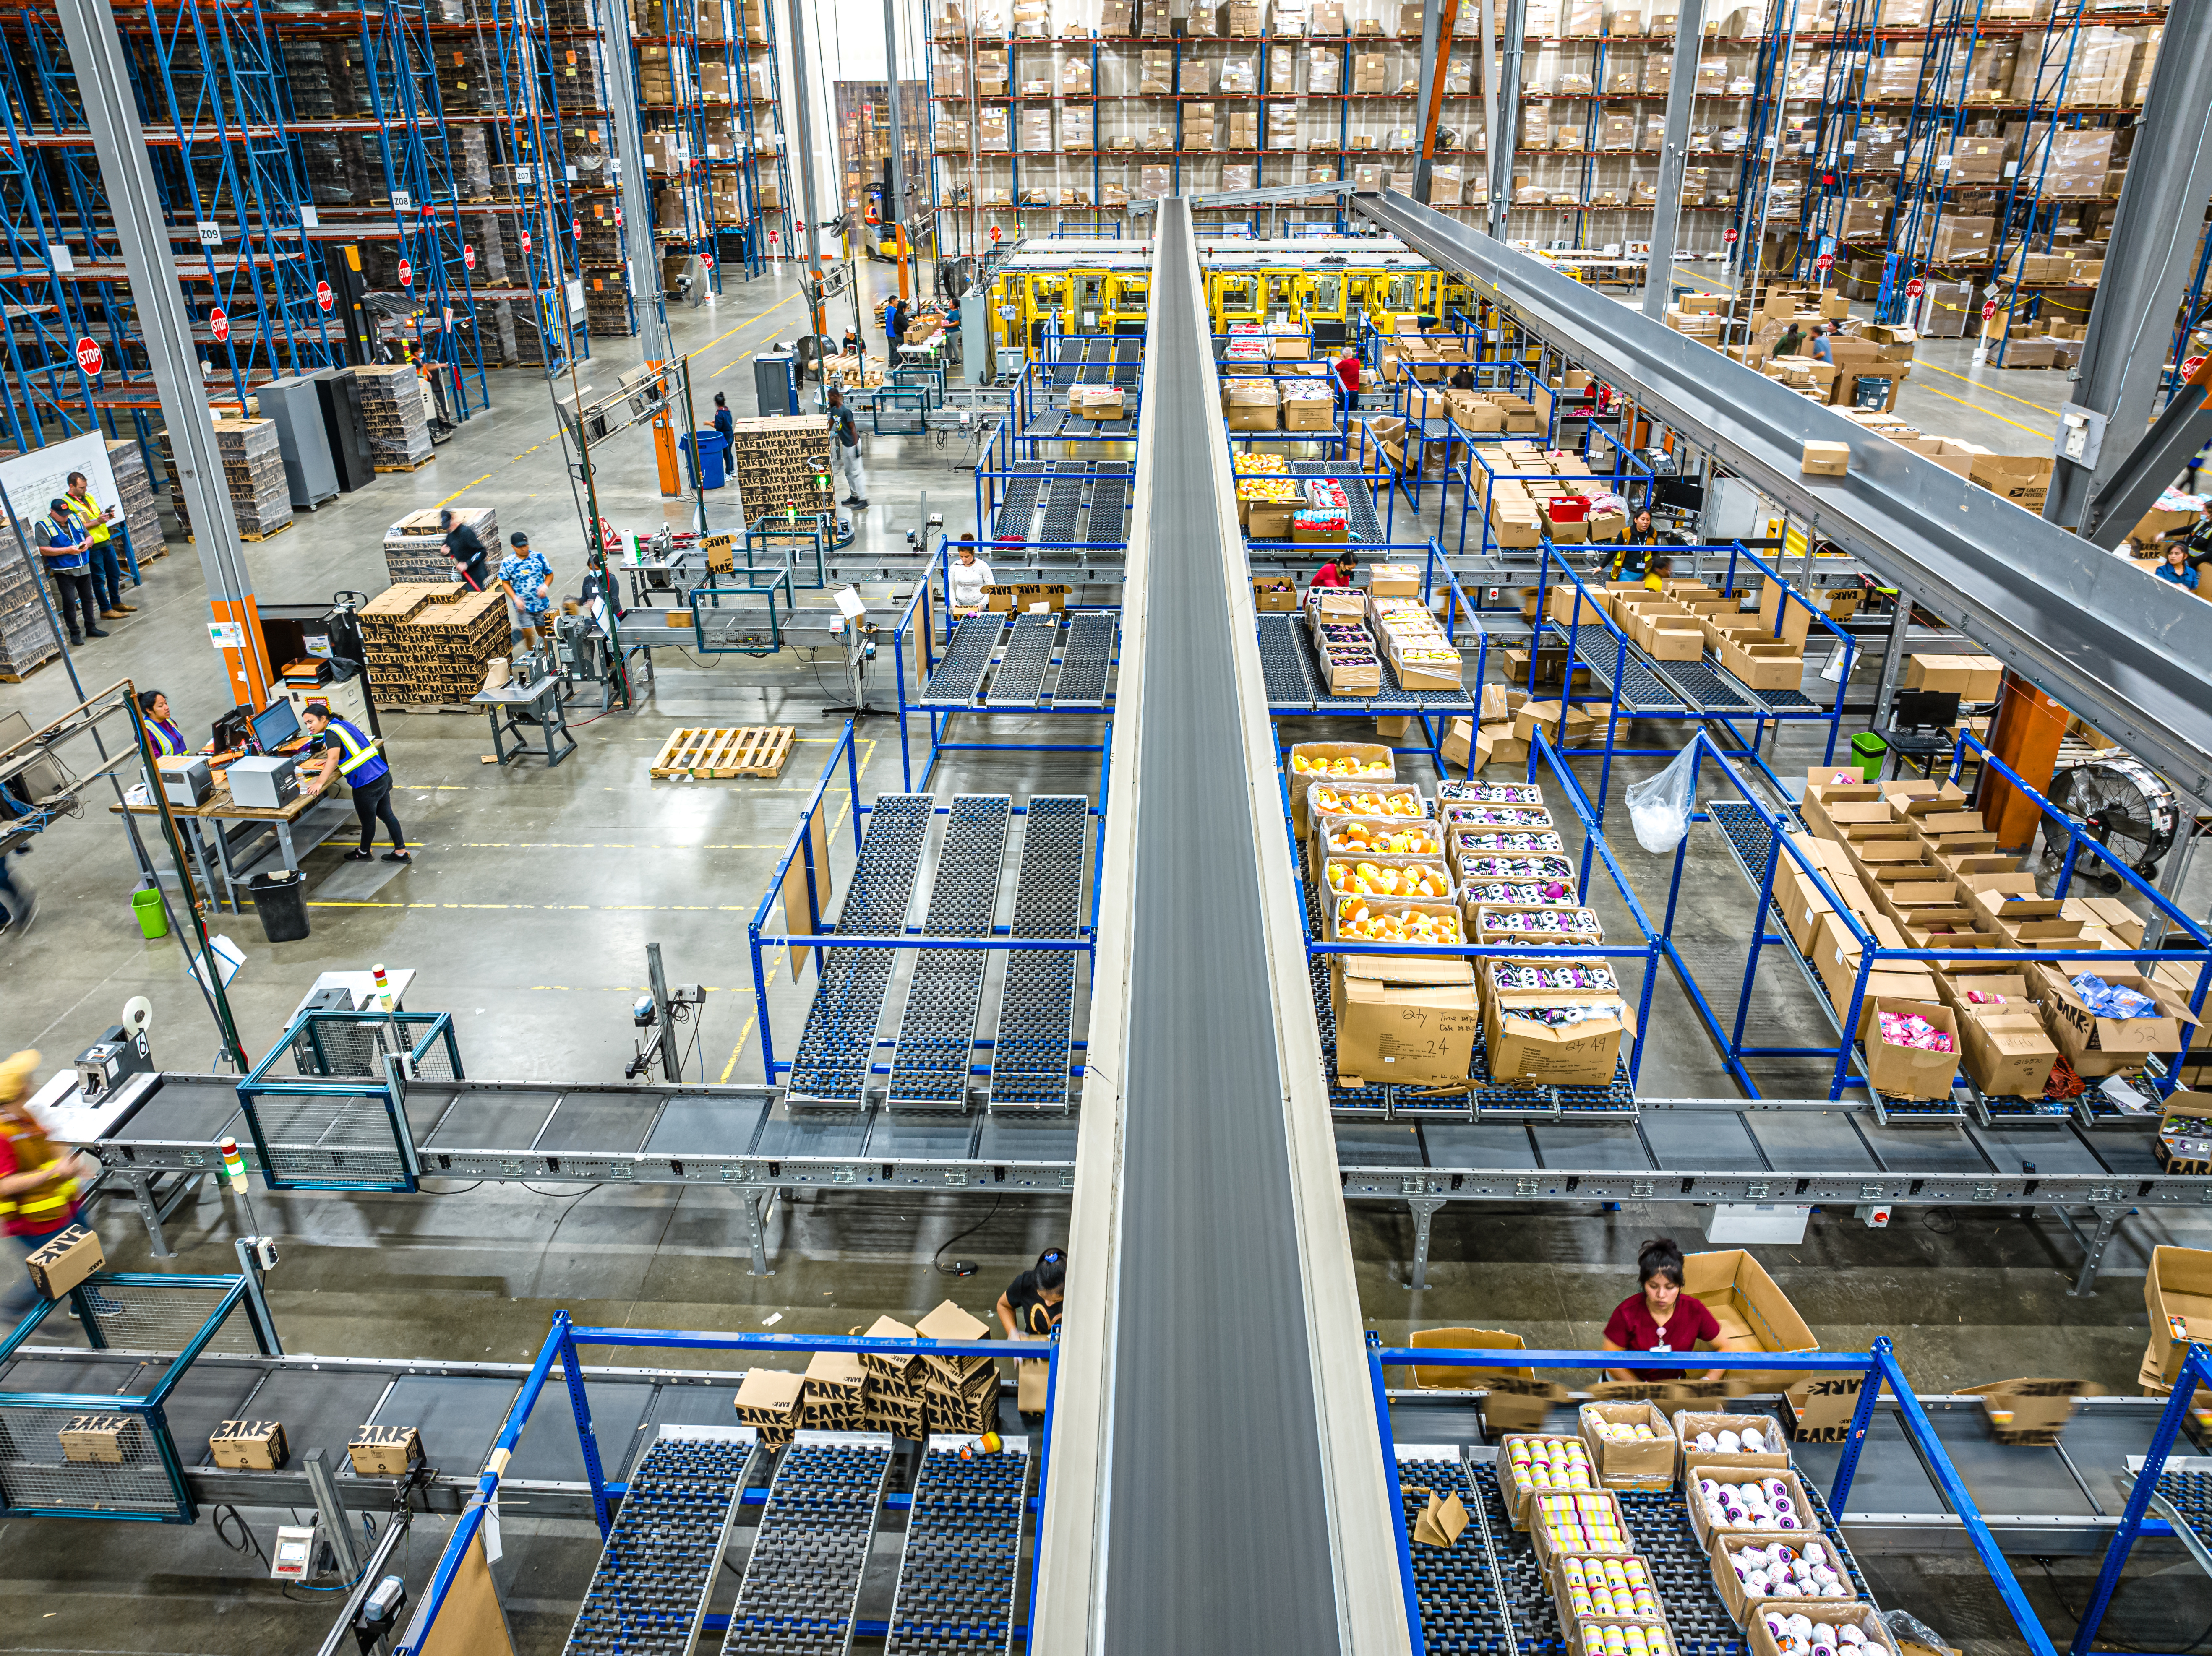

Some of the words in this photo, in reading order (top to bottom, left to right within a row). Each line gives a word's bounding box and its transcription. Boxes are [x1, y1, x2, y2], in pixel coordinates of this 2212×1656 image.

[201, 230, 218, 239] Z09
[465, 253, 474, 262] STOP
[399, 267, 411, 279] STOP
[318, 290, 331, 303] STOP
[212, 318, 227, 332] STOP
[80, 348, 100, 365] STOP
[763, 430, 784, 439] BARK
[785, 430, 806, 438] BARK
[806, 429, 828, 437] BARK
[735, 441, 756, 450] BARK
[756, 440, 778, 449] BARK
[778, 439, 799, 448] BARK
[764, 449, 785, 458] BARK
[786, 448, 807, 457] BARK
[807, 447, 829, 456] BARK
[737, 460, 758, 469] BARK
[759, 458, 780, 468] BARK
[780, 457, 801, 466] BARK
[766, 467, 787, 476] BARK
[788, 466, 808, 475] BARK
[739, 478, 759, 487] BARK
[760, 476, 781, 486] BARK
[782, 476, 803, 484] BARK
[1982, 479, 1993, 488] STATES
[767, 486, 788, 495] BARK
[741, 496, 762, 505] BARK
[762, 495, 784, 504] BARK
[705, 535, 730, 547] BARK
[710, 562, 733, 575] BARK
[987, 585, 1011, 595] BARK
[1016, 584, 1040, 593] BARK
[429, 595, 454, 604] BARK
[1831, 591, 1857, 600] BARK
[382, 614, 406, 623] BARK
[396, 625, 420, 633] BARK
[420, 625, 445, 634] BARK
[444, 625, 469, 634] BARK
[387, 634, 410, 643] BARK
[410, 634, 433, 643] BARK
[403, 645, 426, 654] BARK
[426, 645, 449, 654] BARK
[449, 645, 472, 654] BARK
[390, 654, 414, 663] BARK
[414, 654, 438, 663] BARK
[404, 664, 428, 673] BARK
[428, 664, 452, 673] BARK
[452, 664, 476, 673] BARK
[370, 673, 393, 682] BARK
[393, 673, 417, 682] BARK
[417, 673, 440, 684] BARK
[406, 684, 430, 692] BARK
[430, 684, 454, 693] BARK
[454, 684, 477, 693] BARK
[373, 694, 395, 702] BARK
[396, 694, 419, 702] BARK
[419, 694, 443, 703] BARK
[1439, 1012, 1456, 1021] Time
[2056, 992, 2089, 1034] BARK
[1402, 1008, 1427, 1028] Qty
[2134, 1027, 2160, 1044] 52
[140, 1034, 146, 1055] 6
[1427, 1037, 1449, 1055] 24
[1565, 1041, 1585, 1053] Qty
[1590, 1037, 1606, 1052] 49
[2168, 1160, 2212, 1174] BAR
[34, 1225, 92, 1265] BARK
[87, 1259, 103, 1273] BARK
[891, 1355, 908, 1364] BARK
[858, 1353, 905, 1381] BARK
[806, 1381, 862, 1401] BARK
[870, 1377, 926, 1399] BARK
[927, 1392, 982, 1417] BARK
[806, 1402, 865, 1420] BARK
[867, 1398, 922, 1421] BARK
[736, 1407, 793, 1425] BARK
[927, 1408, 983, 1430] BARK
[213, 1422, 279, 1438] BARK
[866, 1419, 921, 1437] BARK
[350, 1426, 417, 1443] BARK
